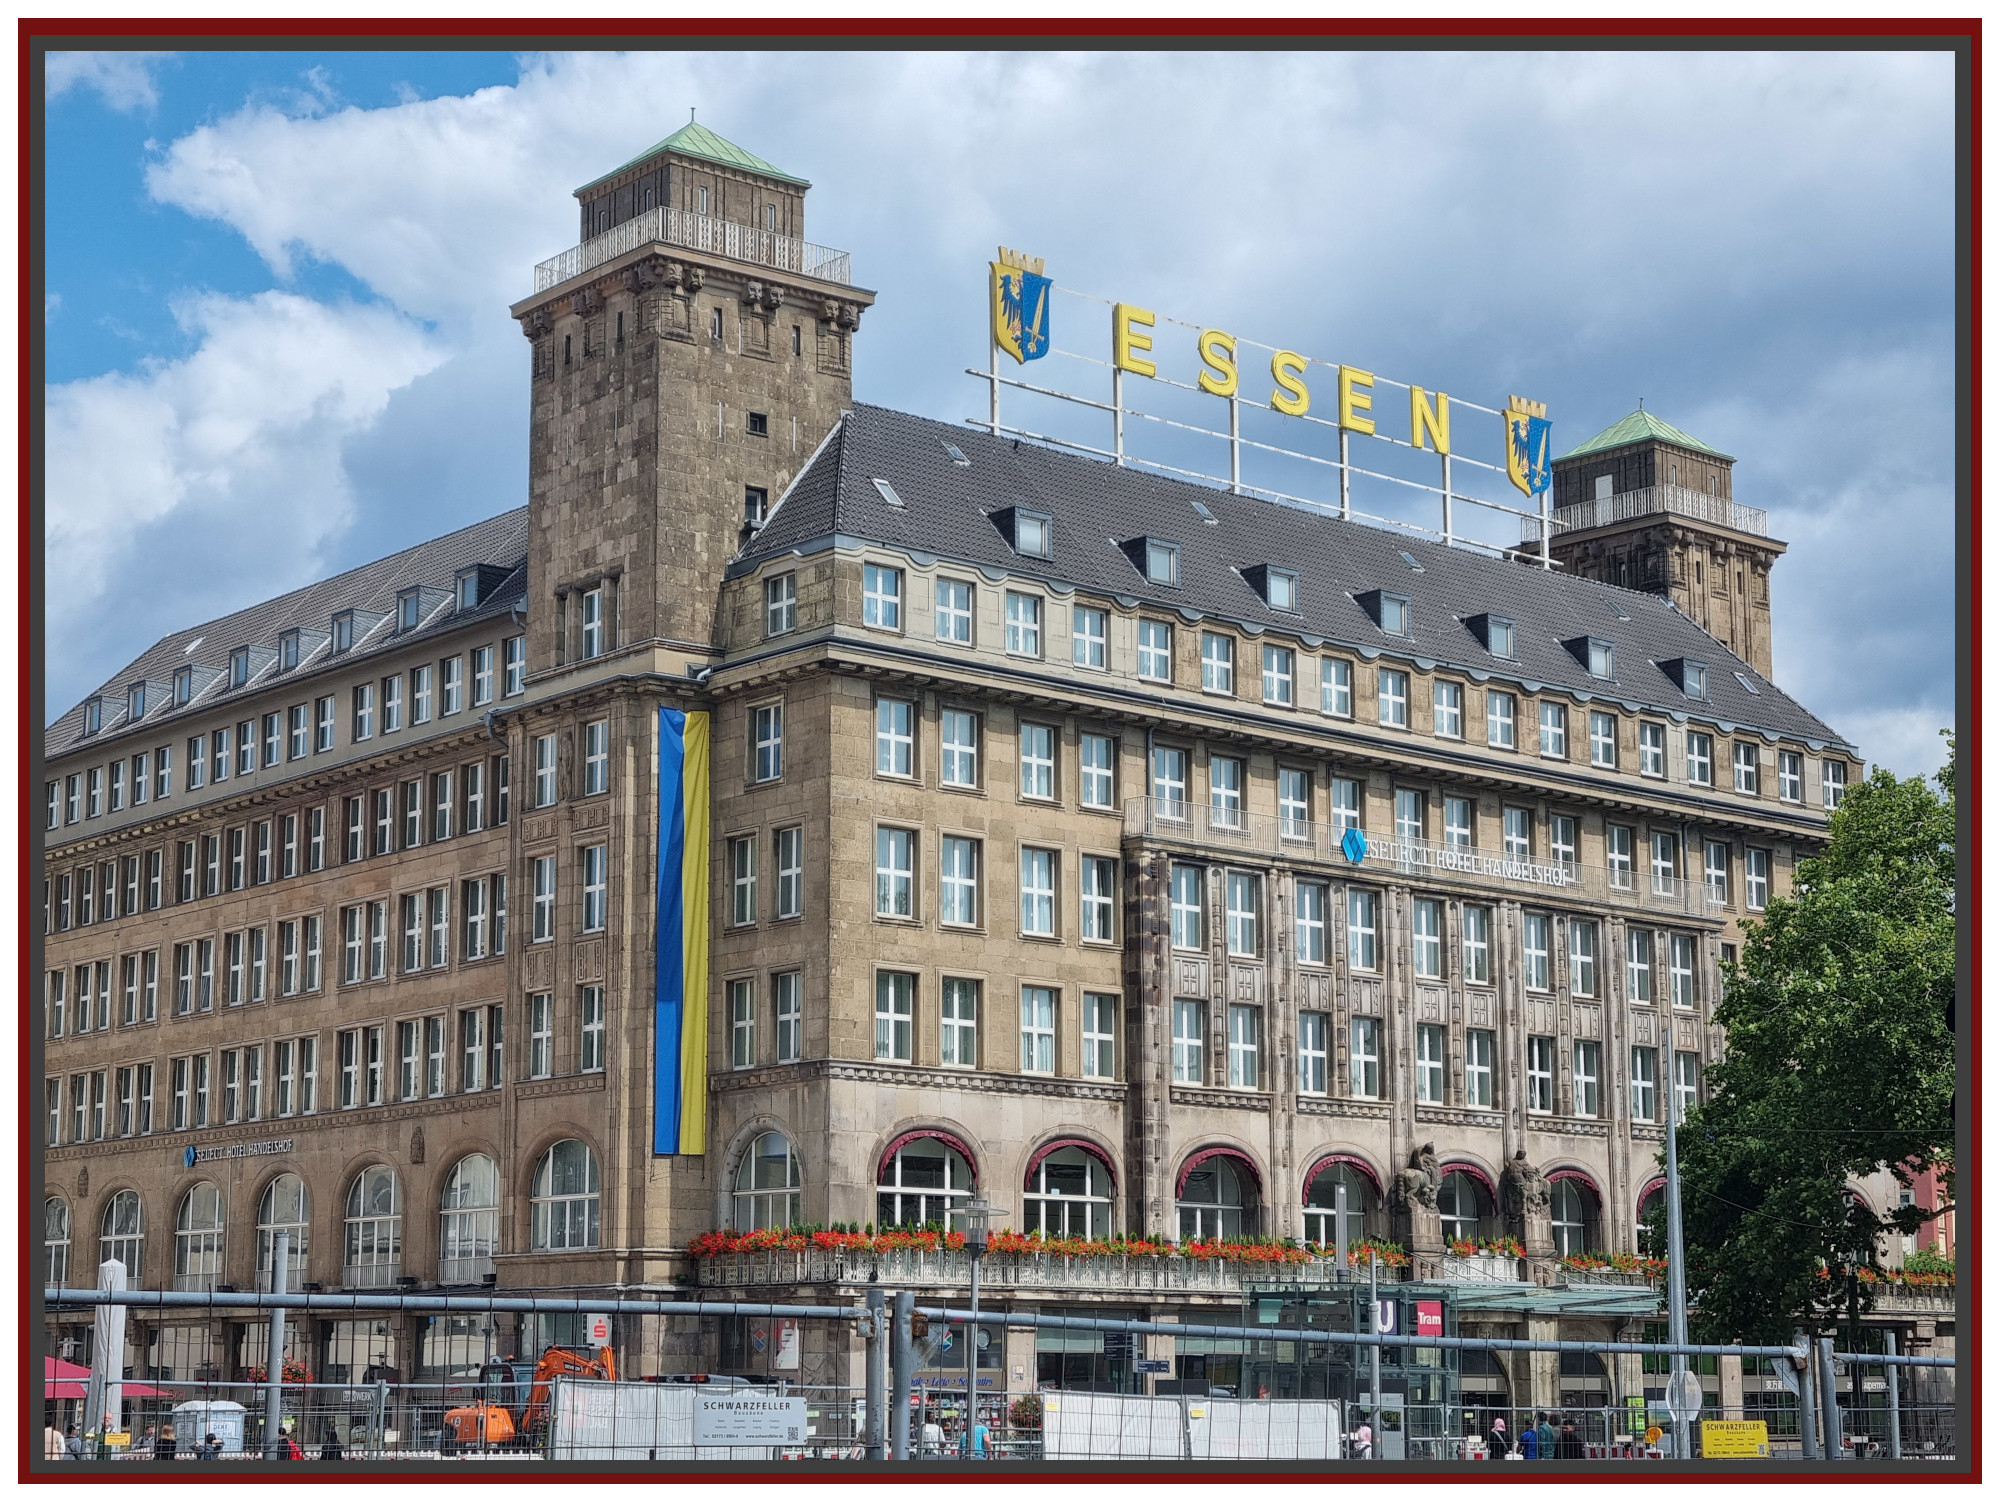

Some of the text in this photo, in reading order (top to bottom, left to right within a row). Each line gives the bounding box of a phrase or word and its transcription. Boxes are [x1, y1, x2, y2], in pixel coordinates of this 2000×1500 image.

[1113, 302, 1450, 455] ESSEN
[1368, 839, 1570, 887] SELECT HOTEL HANDELSHOF
[196, 1139, 293, 1162] SELECT HOTEL HANDELSHOF
[1376, 1301, 1441, 1333] U Tram
[957, 1376, 993, 1387] Sonirs
[343, 1391, 373, 1402] bakWERK
[703, 1401, 791, 1410] SCHWARZFELLER
[1706, 1423, 1761, 1431] SCHWARZFELLER
